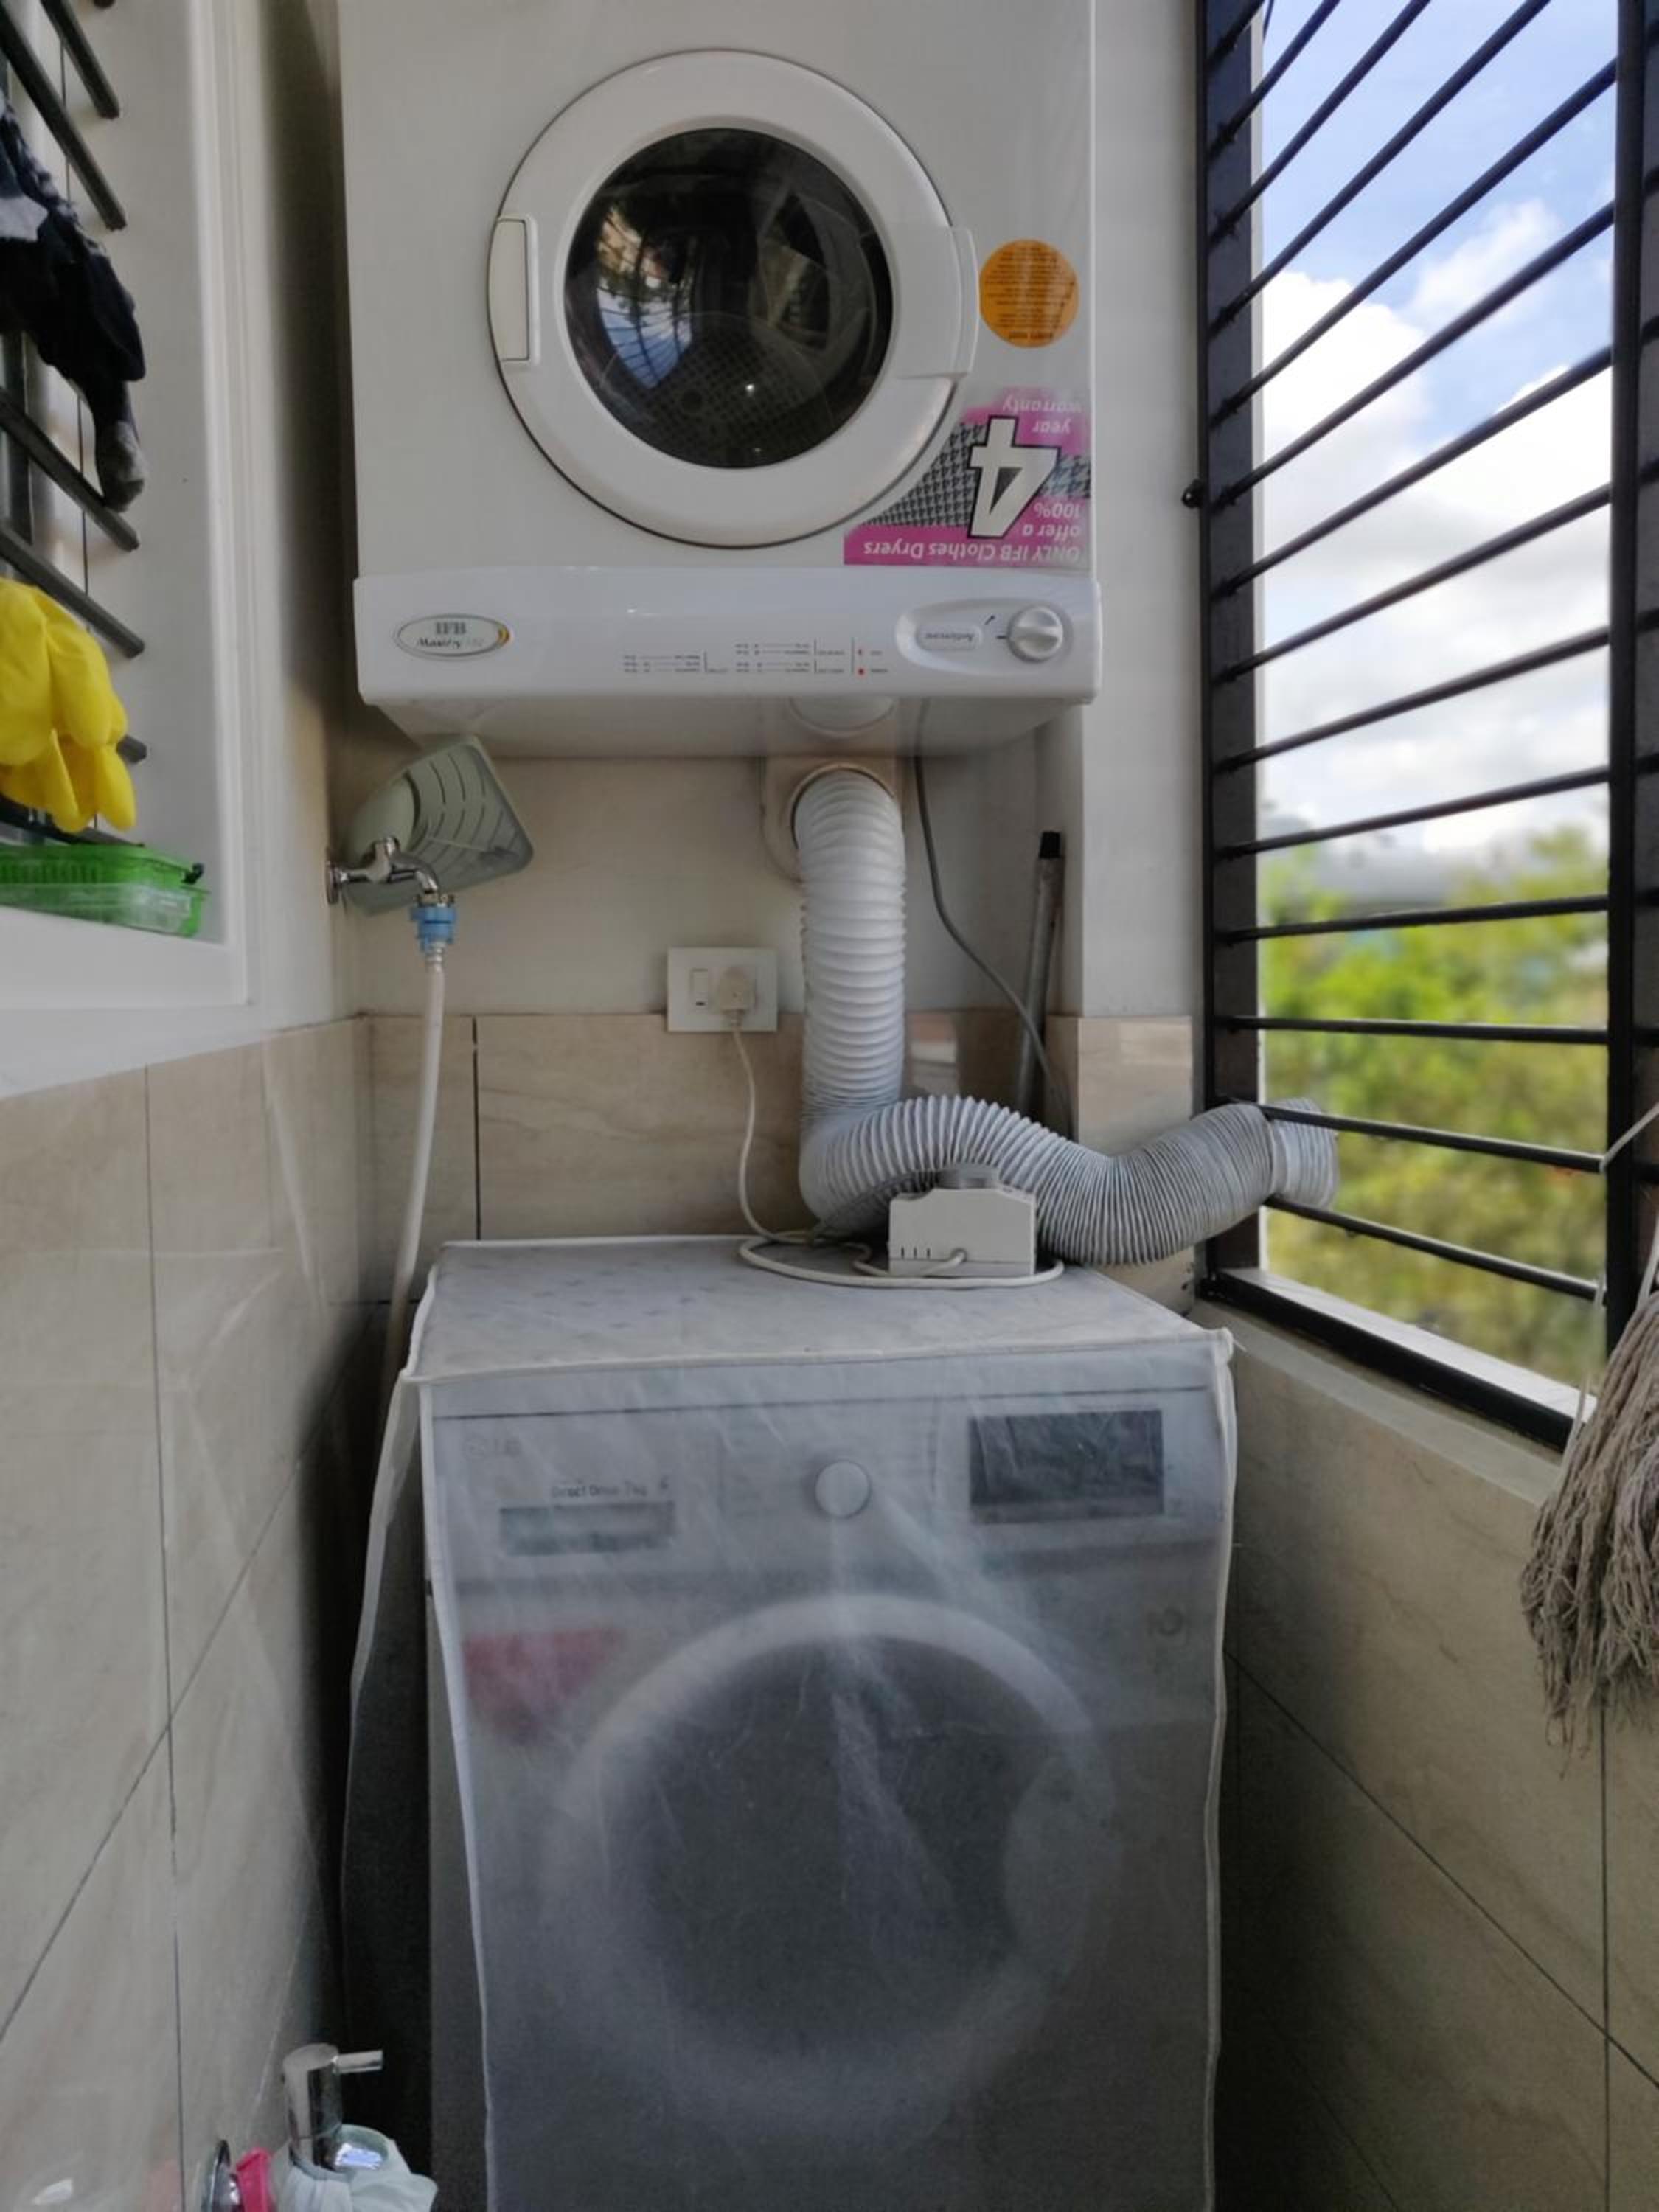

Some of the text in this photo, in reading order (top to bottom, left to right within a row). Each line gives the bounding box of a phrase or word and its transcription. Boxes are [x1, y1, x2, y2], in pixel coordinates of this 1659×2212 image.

[1002, 395, 1082, 414] warranty
[1032, 417, 1071, 437] year
[967, 415, 1061, 539] 4
[1034, 502, 1080, 518] 100%
[1022, 524, 1080, 541] offer a
[863, 538, 1080, 560] ONLY IFB Clothes Dryers
